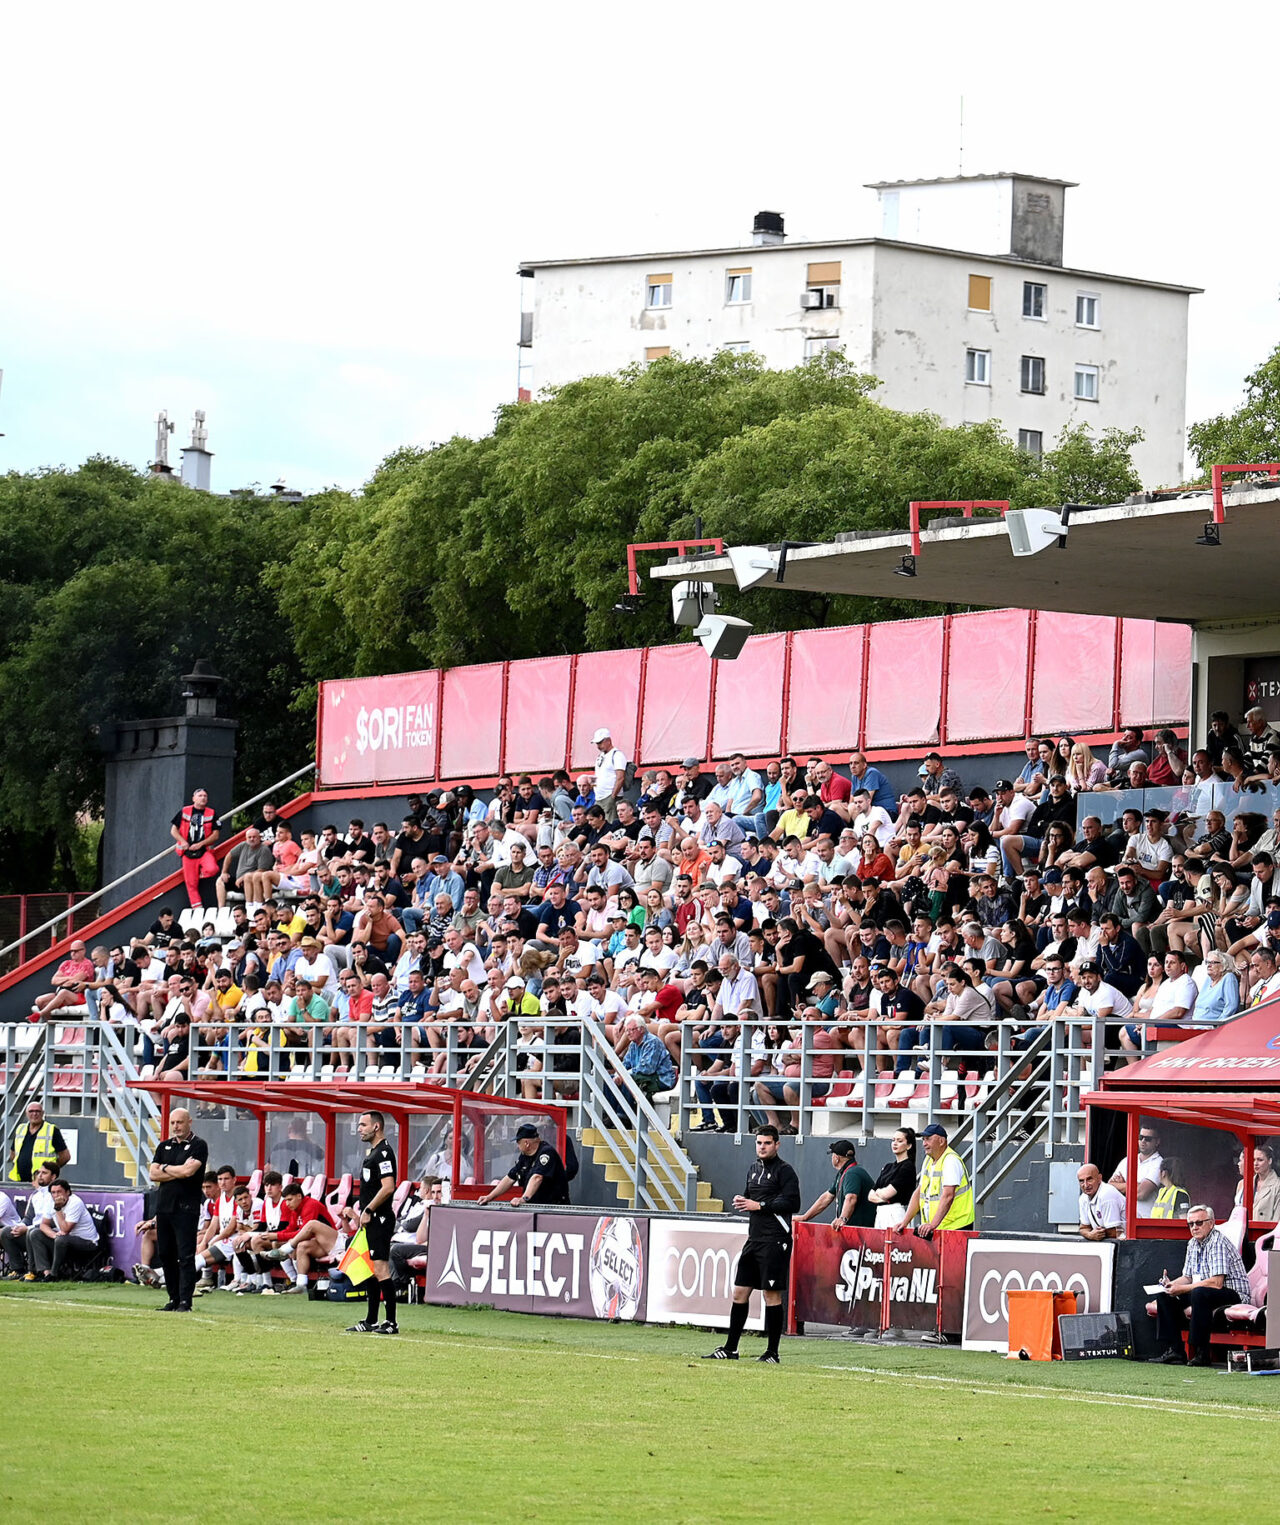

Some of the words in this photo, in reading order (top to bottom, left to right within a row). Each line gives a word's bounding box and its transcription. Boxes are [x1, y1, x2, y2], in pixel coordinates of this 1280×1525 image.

[356, 705, 404, 755] $ORI
[405, 703, 433, 730] FAN
[405, 730, 432, 747] TOKEN
[470, 1229, 584, 1299] SELECT
[603, 1247, 634, 1285] SELECT
[665, 1246, 744, 1299] com
